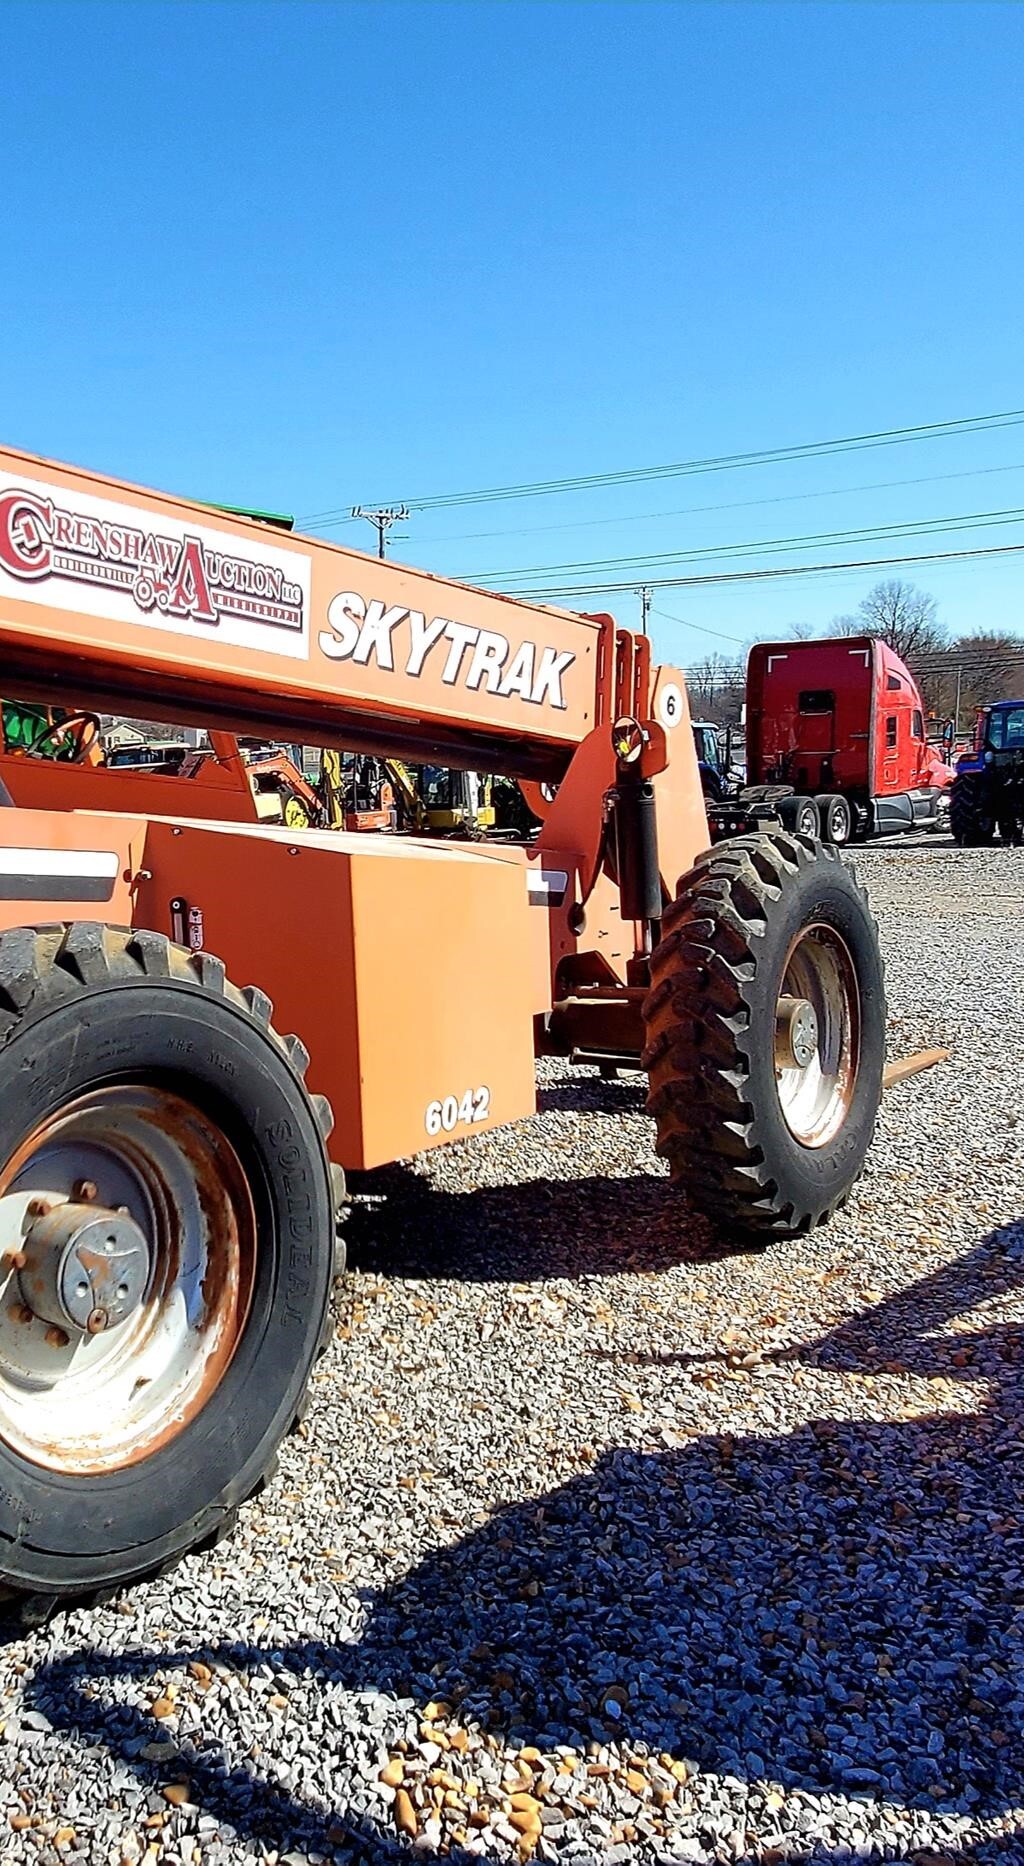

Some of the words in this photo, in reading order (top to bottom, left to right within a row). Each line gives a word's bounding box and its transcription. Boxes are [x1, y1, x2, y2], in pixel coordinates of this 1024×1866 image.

[169, 535, 283, 619] AUCTION
[318, 591, 575, 709] SKYTRAK
[666, 695, 676, 716] 6
[425, 1085, 490, 1136] 6042
[265, 1118, 313, 1328] SOLIDEAL
